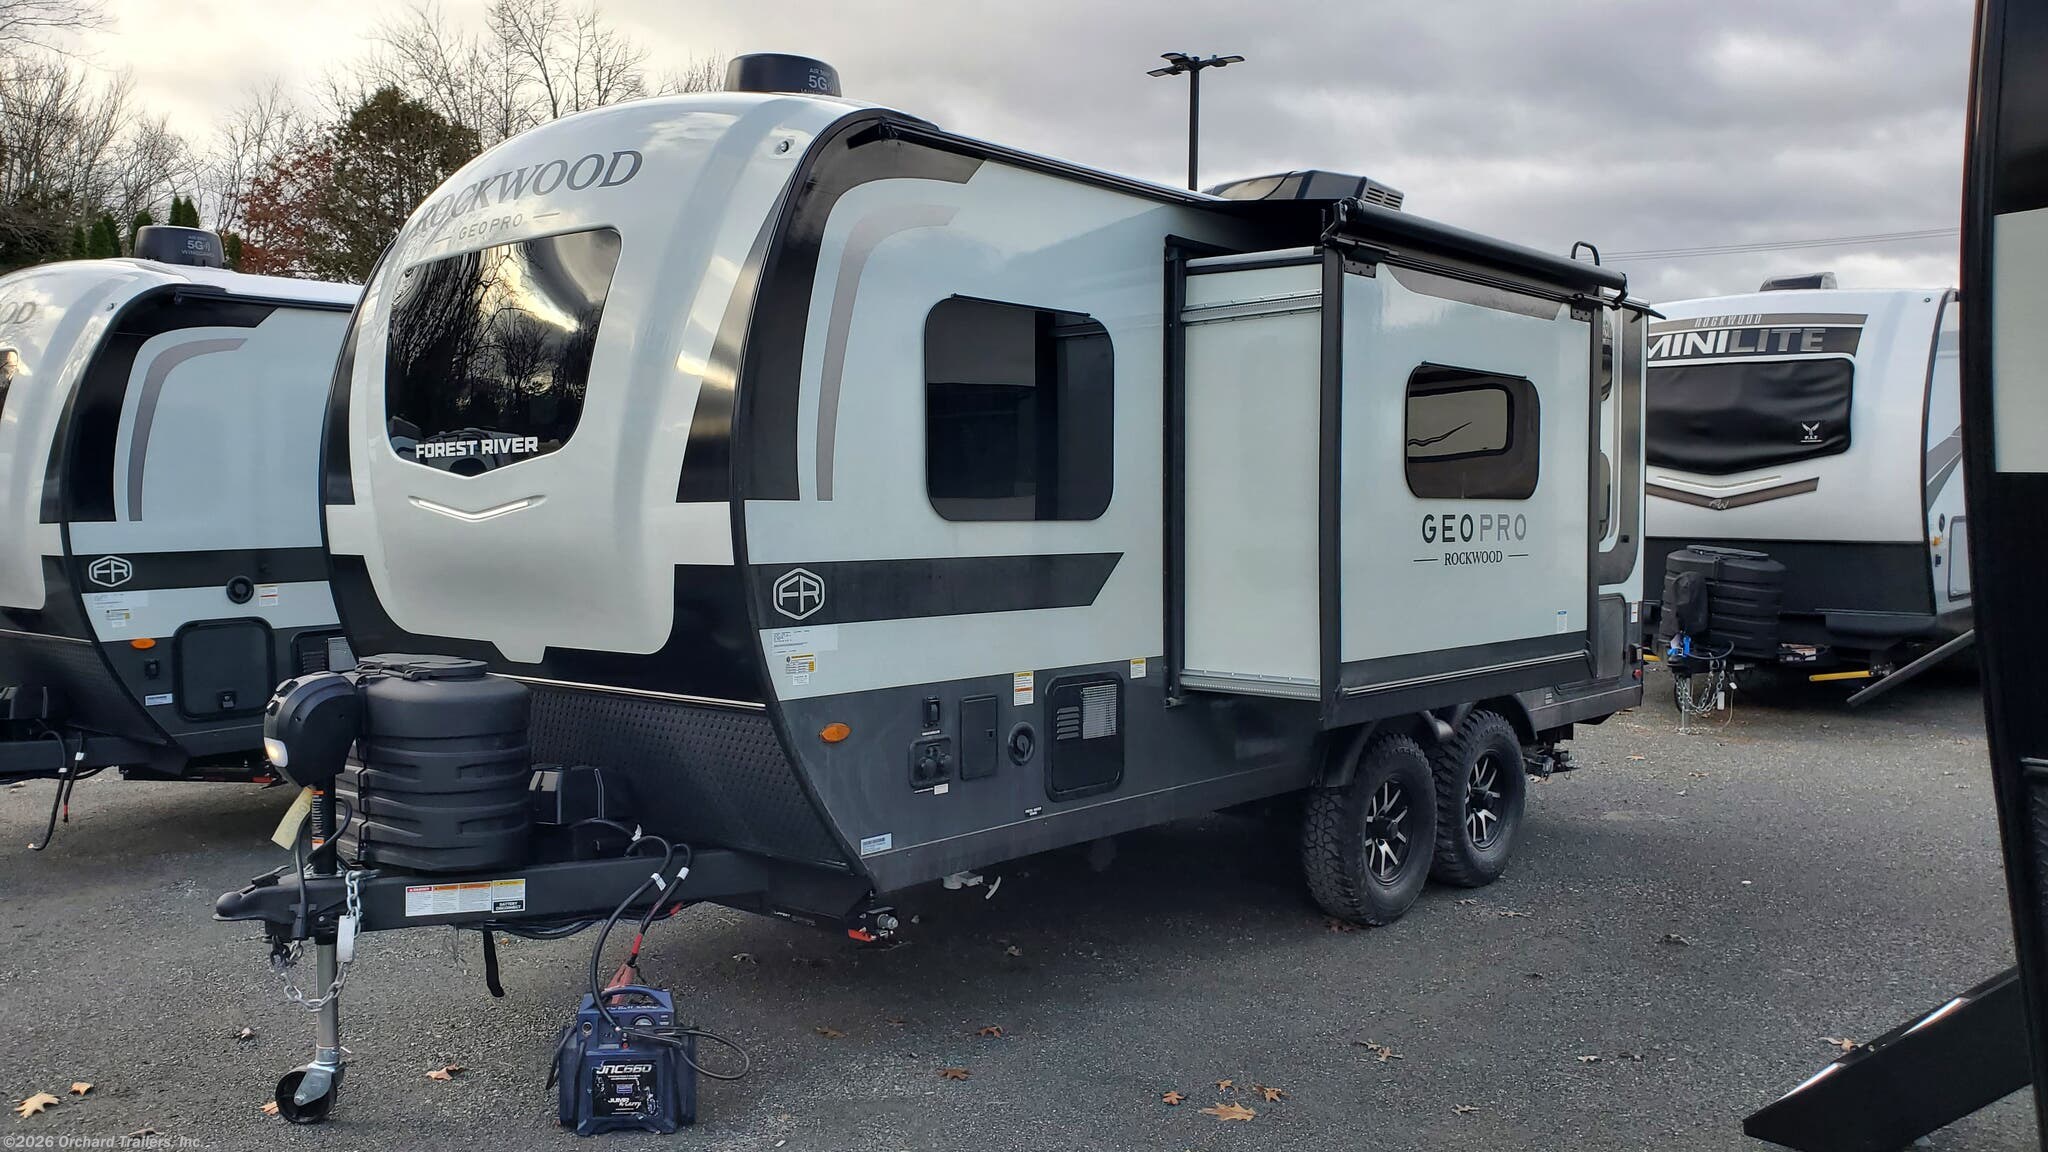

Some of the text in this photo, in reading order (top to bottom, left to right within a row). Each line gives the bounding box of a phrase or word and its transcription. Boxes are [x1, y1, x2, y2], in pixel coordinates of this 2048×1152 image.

[411, 149, 643, 239] ROCKWOOD
[458, 213, 523, 240] GEOPRO
[1694, 314, 1763, 329] ROCKWOOD
[415, 436, 539, 459] FOREST RIVER
[1444, 550, 1504, 567] ROCKWOOD
